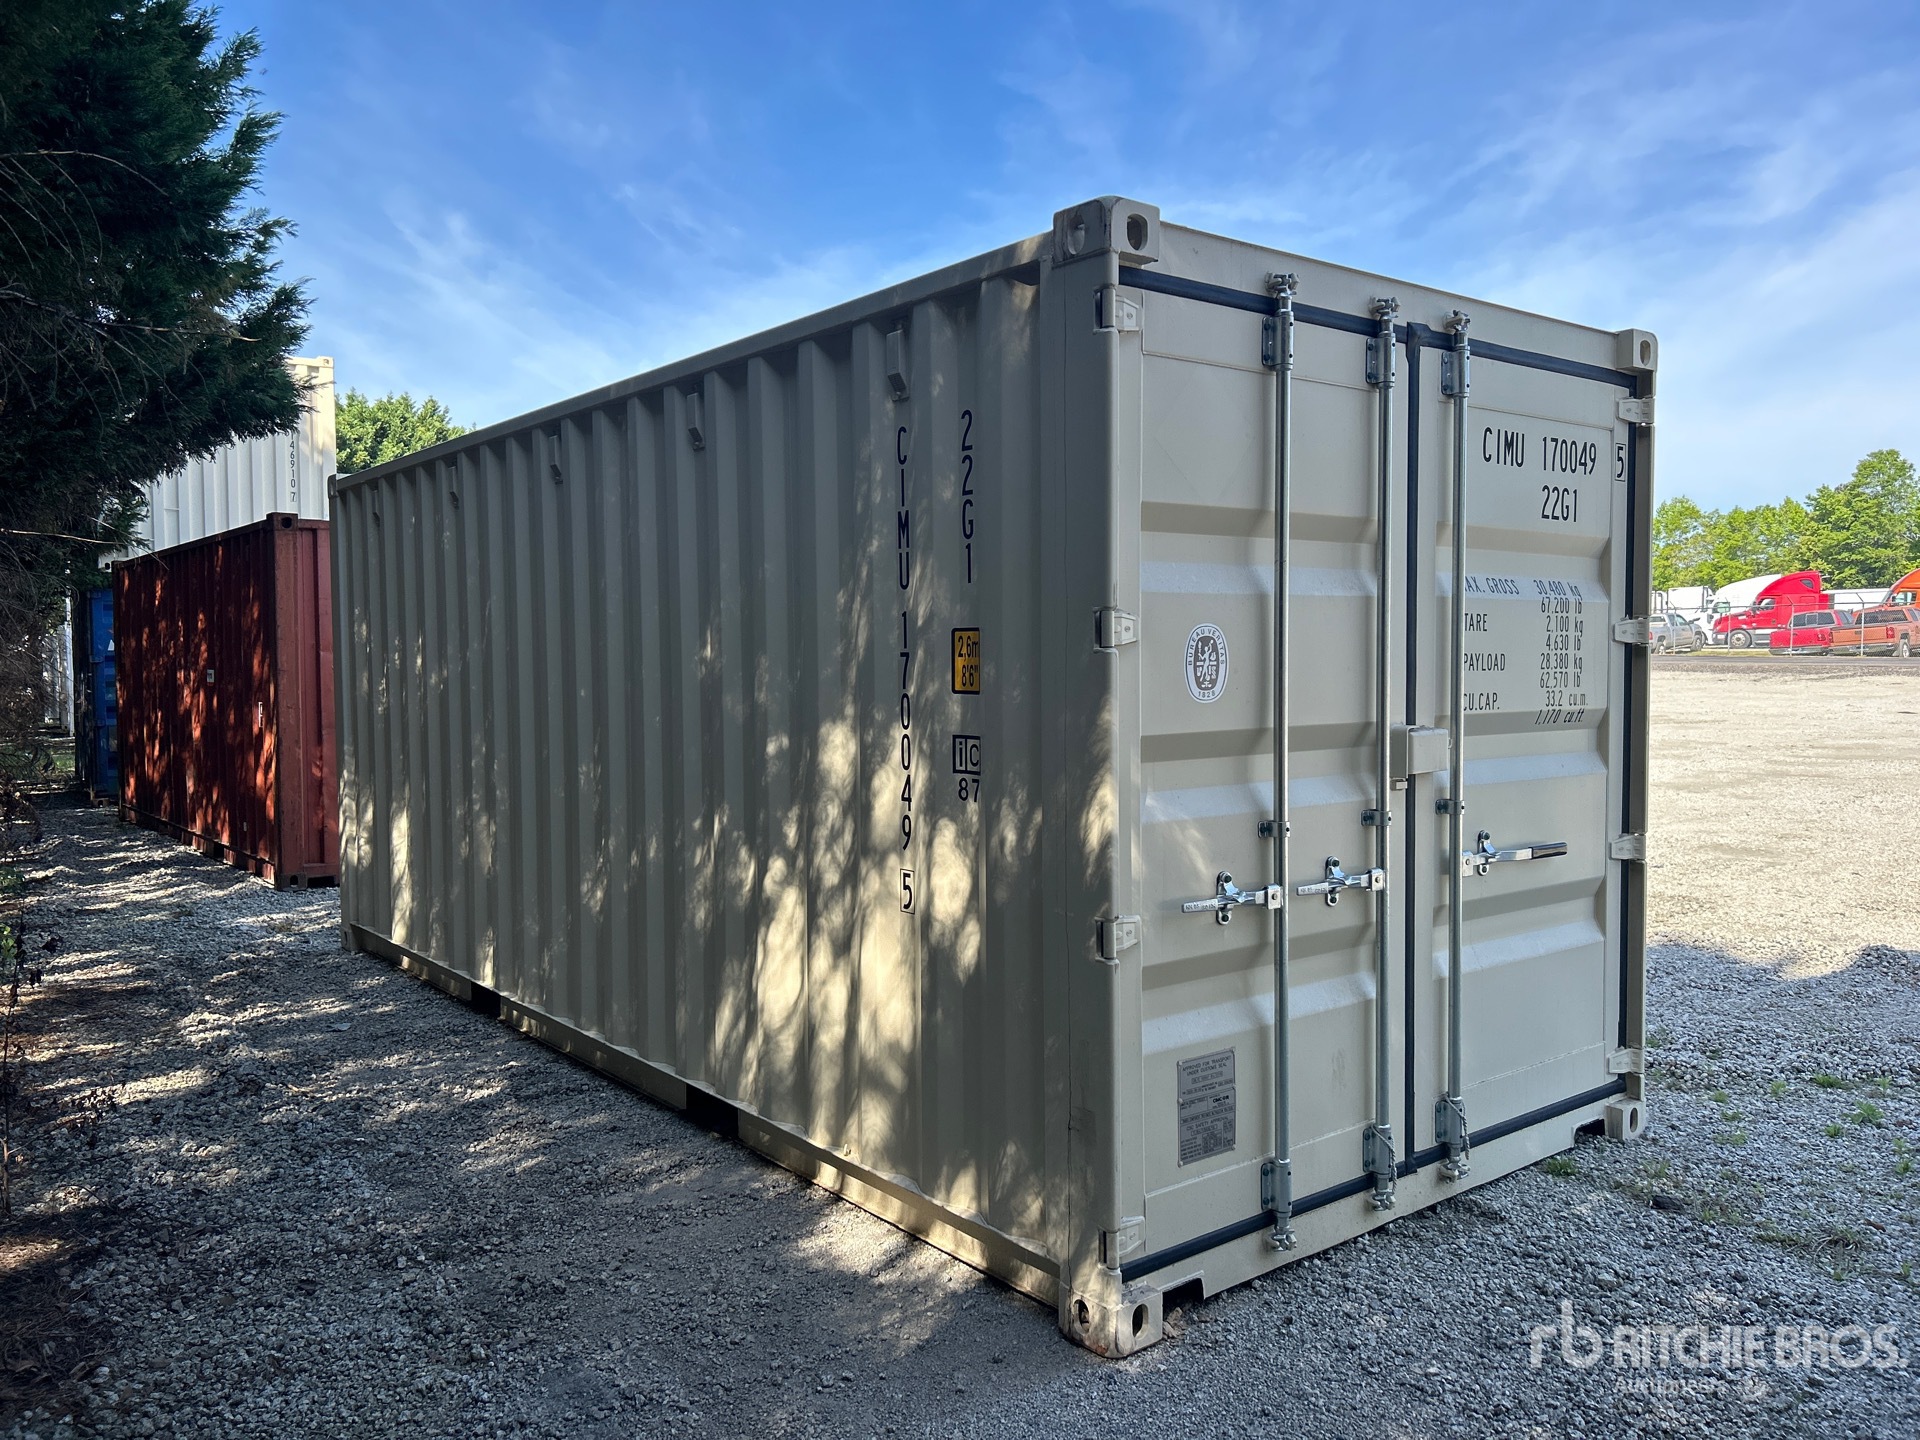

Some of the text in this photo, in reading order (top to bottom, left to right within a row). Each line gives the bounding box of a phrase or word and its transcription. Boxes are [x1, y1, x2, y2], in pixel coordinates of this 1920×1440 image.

[1482, 426, 1625, 479] CIMU 170049 5
[960, 409, 975, 584] 22G1
[1541, 484, 1578, 523] 22G1
[1464, 575, 1486, 593] AX.
[1485, 577, 1520, 595] GROSS
[1567, 581, 1583, 602] kg
[1574, 597, 1583, 614] lb
[1464, 612, 1488, 632] TARE
[1574, 616, 1584, 638] kg
[1573, 634, 1582, 651] lb
[897, 426, 913, 910] CIMU 170049 5
[1463, 652, 1506, 672] PAYLOAD
[1573, 653, 1583, 674] kg
[1573, 672, 1581, 688] lb
[1545, 689, 1563, 707] 33.2
[958, 777, 980, 803] 87
